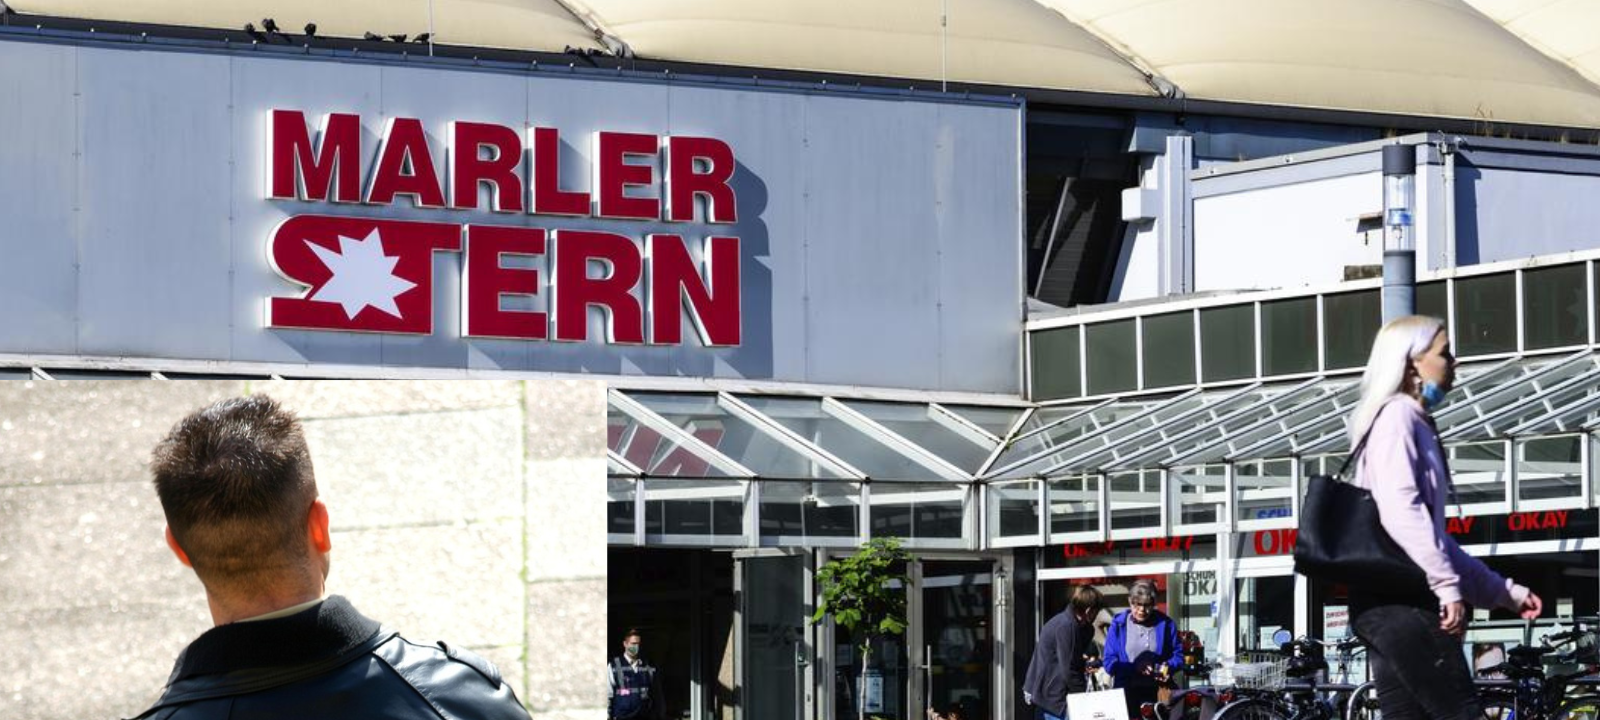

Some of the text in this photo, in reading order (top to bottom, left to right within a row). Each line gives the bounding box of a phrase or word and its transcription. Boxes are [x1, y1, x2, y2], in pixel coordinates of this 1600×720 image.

[266, 108, 738, 224] MARLER
[265, 214, 742, 347] STERN
[1508, 511, 1569, 532] OKAY
